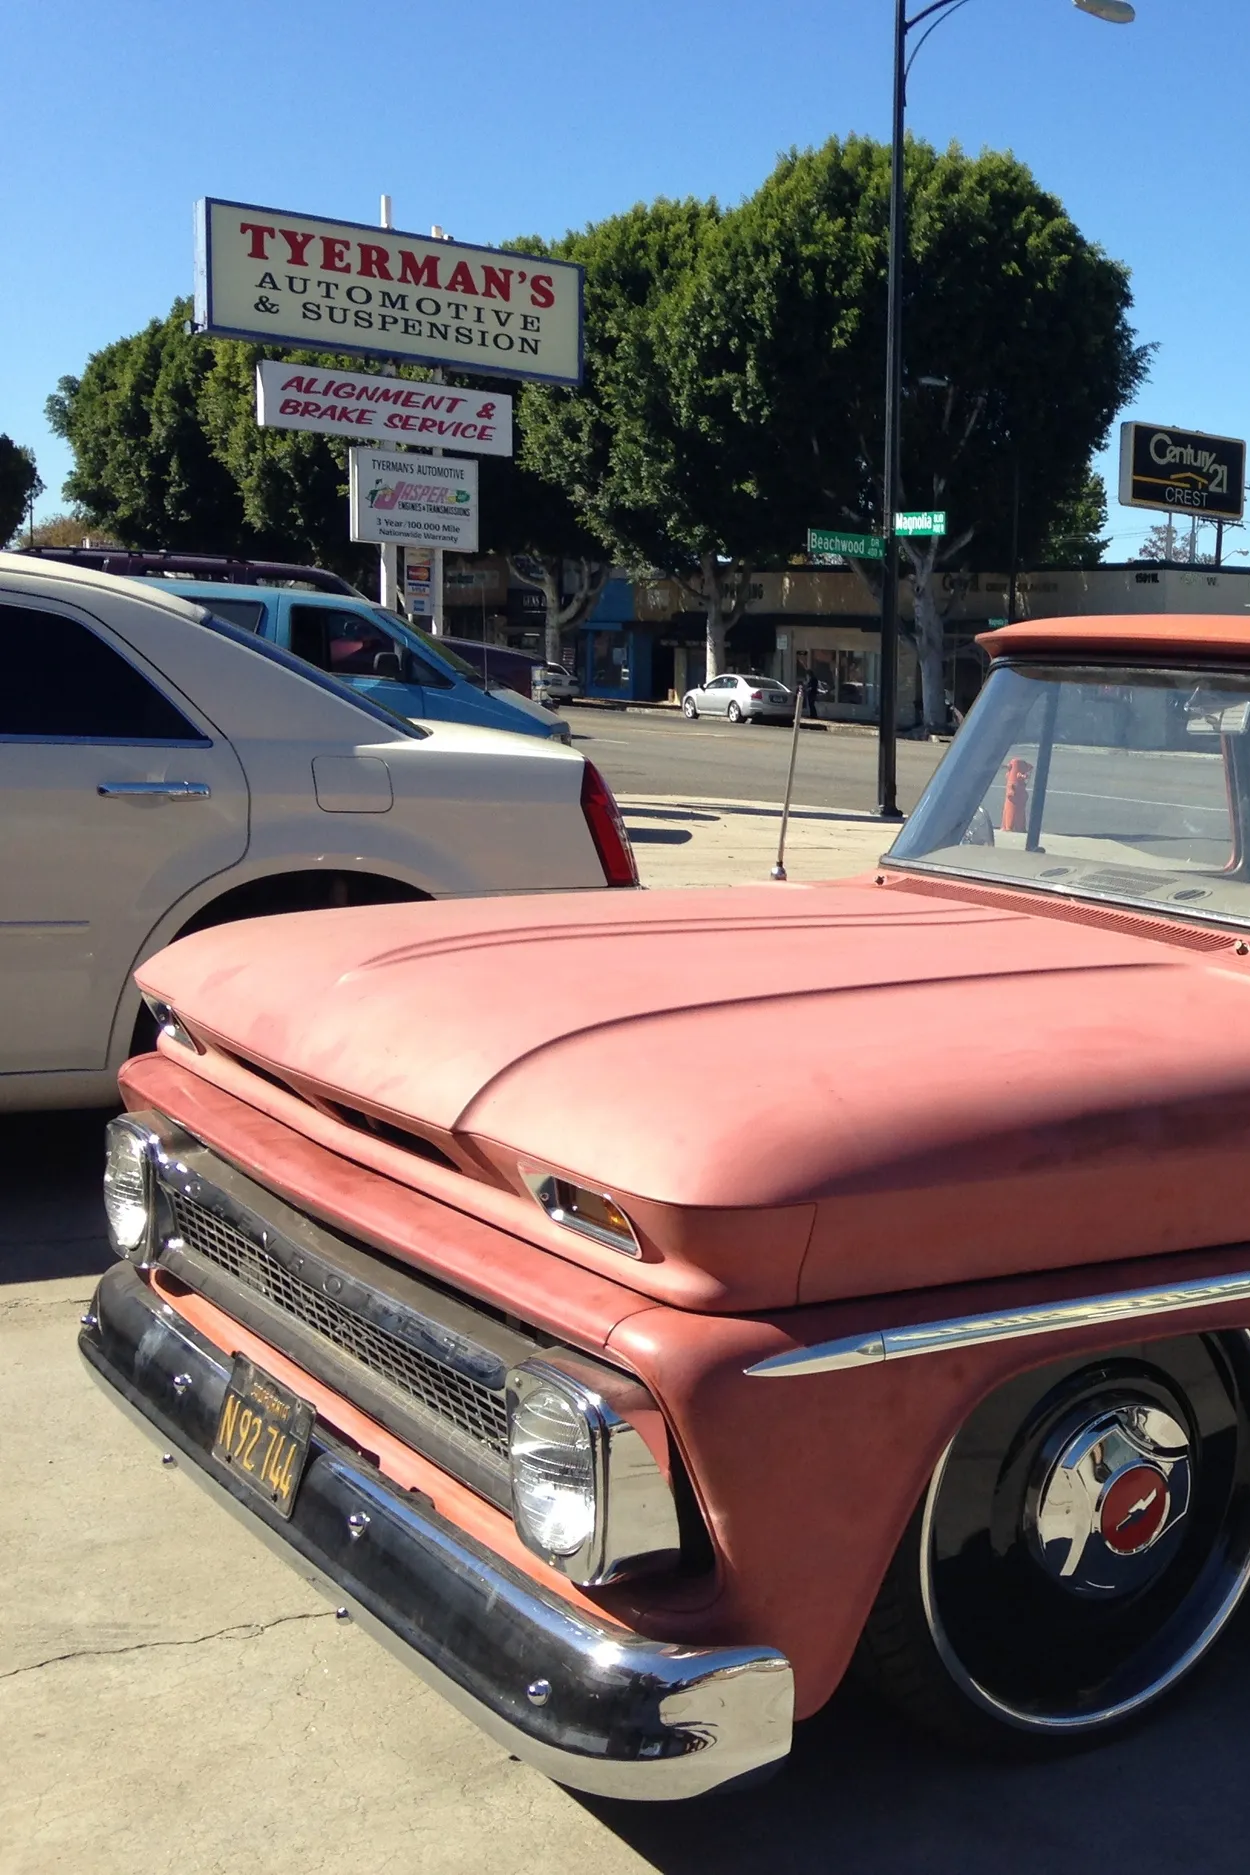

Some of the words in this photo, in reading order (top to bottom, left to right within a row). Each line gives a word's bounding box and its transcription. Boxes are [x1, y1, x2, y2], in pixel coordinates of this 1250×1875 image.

[240, 222, 556, 309] TYERMAN'S
[254, 272, 541, 333] AUTOMOTIVE
[253, 295, 280, 315] &
[302, 302, 542, 356] SUSPENSION
[280, 375, 468, 414] ALIGNMENT
[475, 402, 497, 420] &
[279, 398, 377, 425] BRAKE
[383, 412, 497, 441] SERVICE
[372, 459, 414, 474] TYERMAN'S
[417, 465, 465, 480] AUTOMOTIVE
[1149, 432, 1217, 473] Century
[1208, 463, 1229, 494] 21
[397, 501, 422, 512] ENGINES
[1165, 486, 1209, 507] CREST
[376, 518, 382, 526] 3
[441, 524, 460, 534] Mile
[895, 512, 932, 535] Magnolia
[379, 528, 422, 539] Nationwide
[423, 531, 458, 544] Warranty
[810, 532, 865, 555] Beachwood
